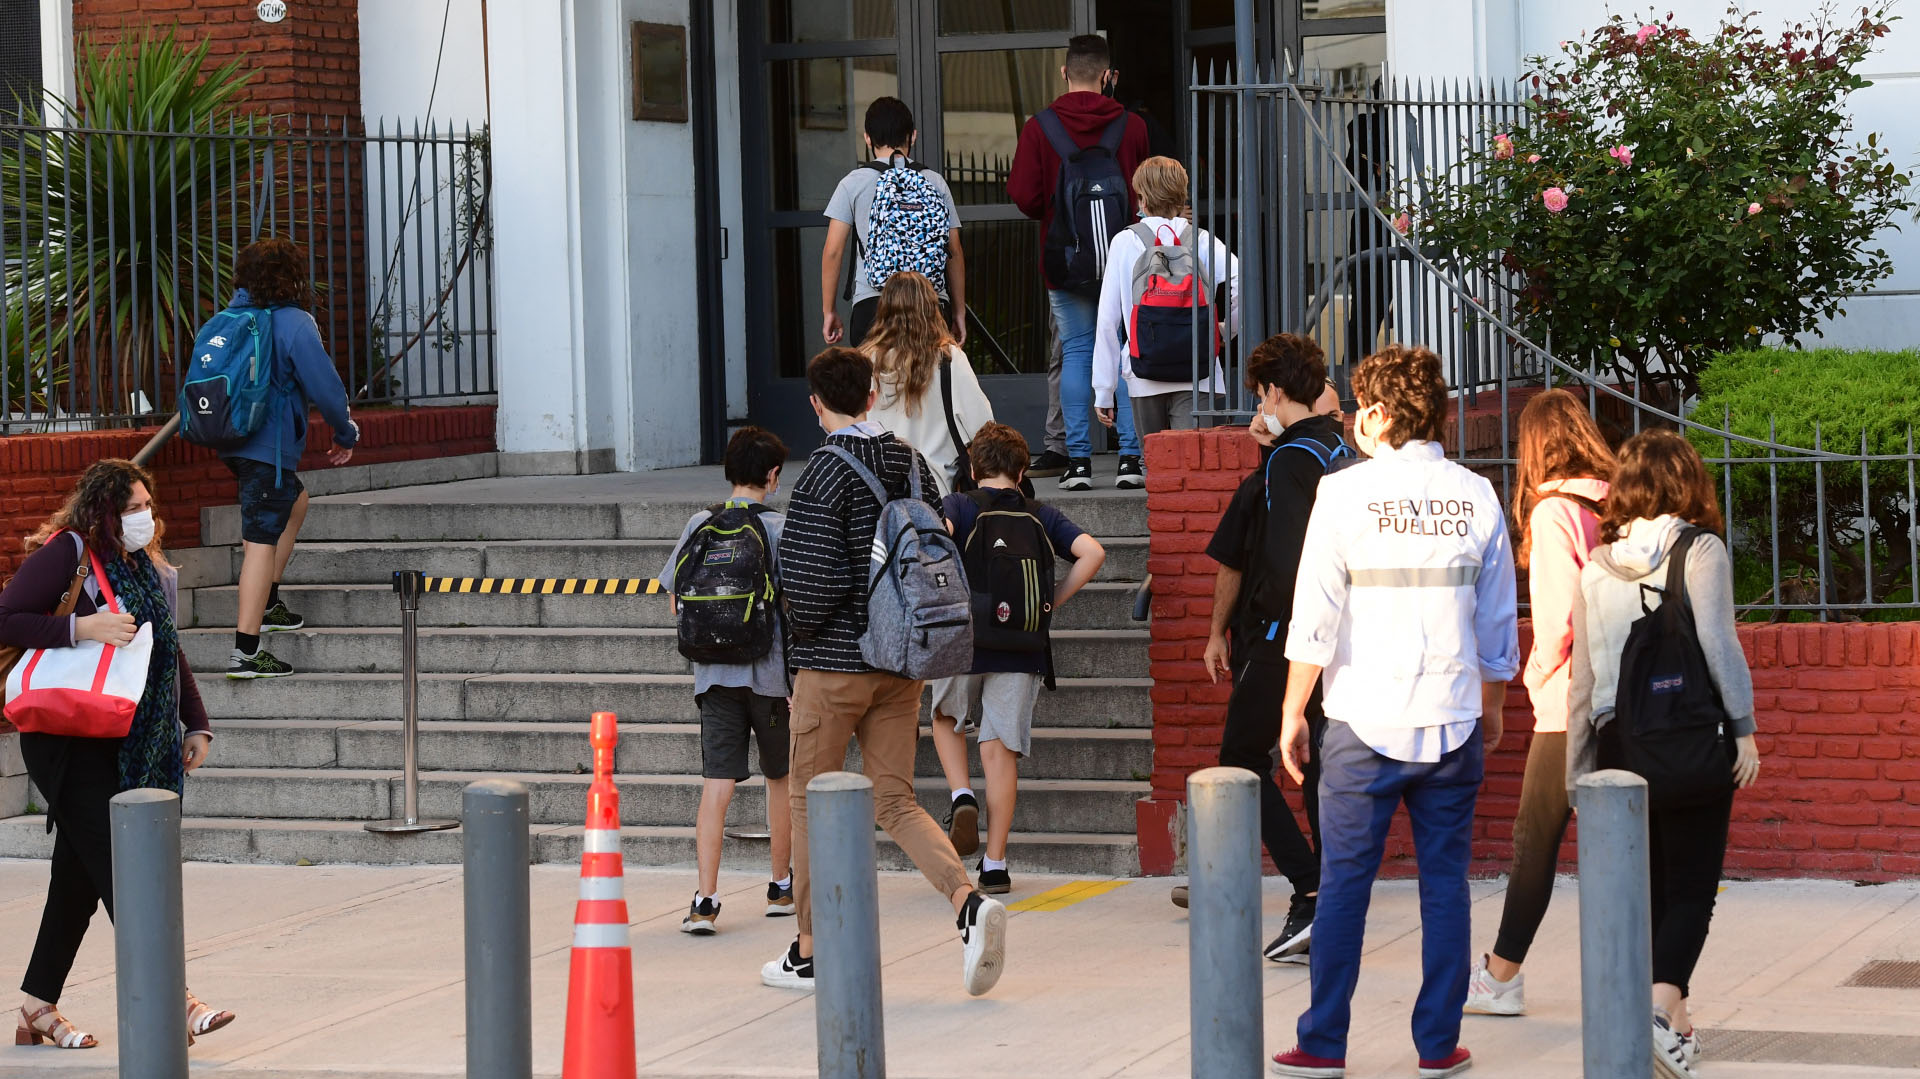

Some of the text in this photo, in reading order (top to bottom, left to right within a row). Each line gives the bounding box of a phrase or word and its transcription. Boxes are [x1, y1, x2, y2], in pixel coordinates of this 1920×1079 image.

[260, 3, 283, 17] 6796
[1367, 499, 1474, 517] SERVIDOR
[1378, 517, 1468, 537] PUBLICO
